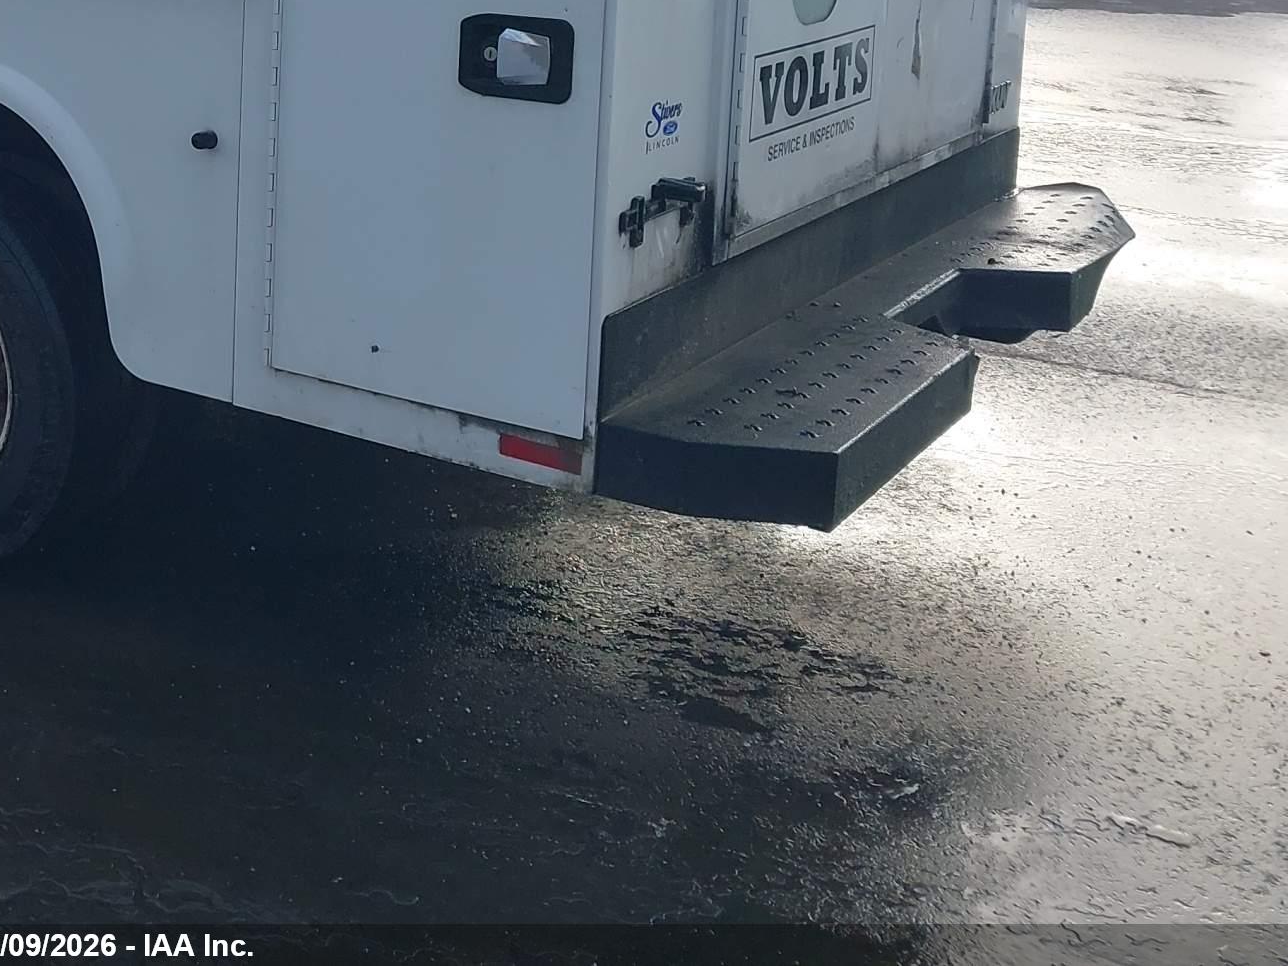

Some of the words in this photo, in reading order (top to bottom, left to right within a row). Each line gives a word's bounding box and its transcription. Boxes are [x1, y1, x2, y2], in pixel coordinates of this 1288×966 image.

[759, 37, 870, 125] VOLTS
[767, 135, 801, 162] SERVICE
[802, 133, 807, 148] &
[809, 116, 855, 147] INSPECTIONS
